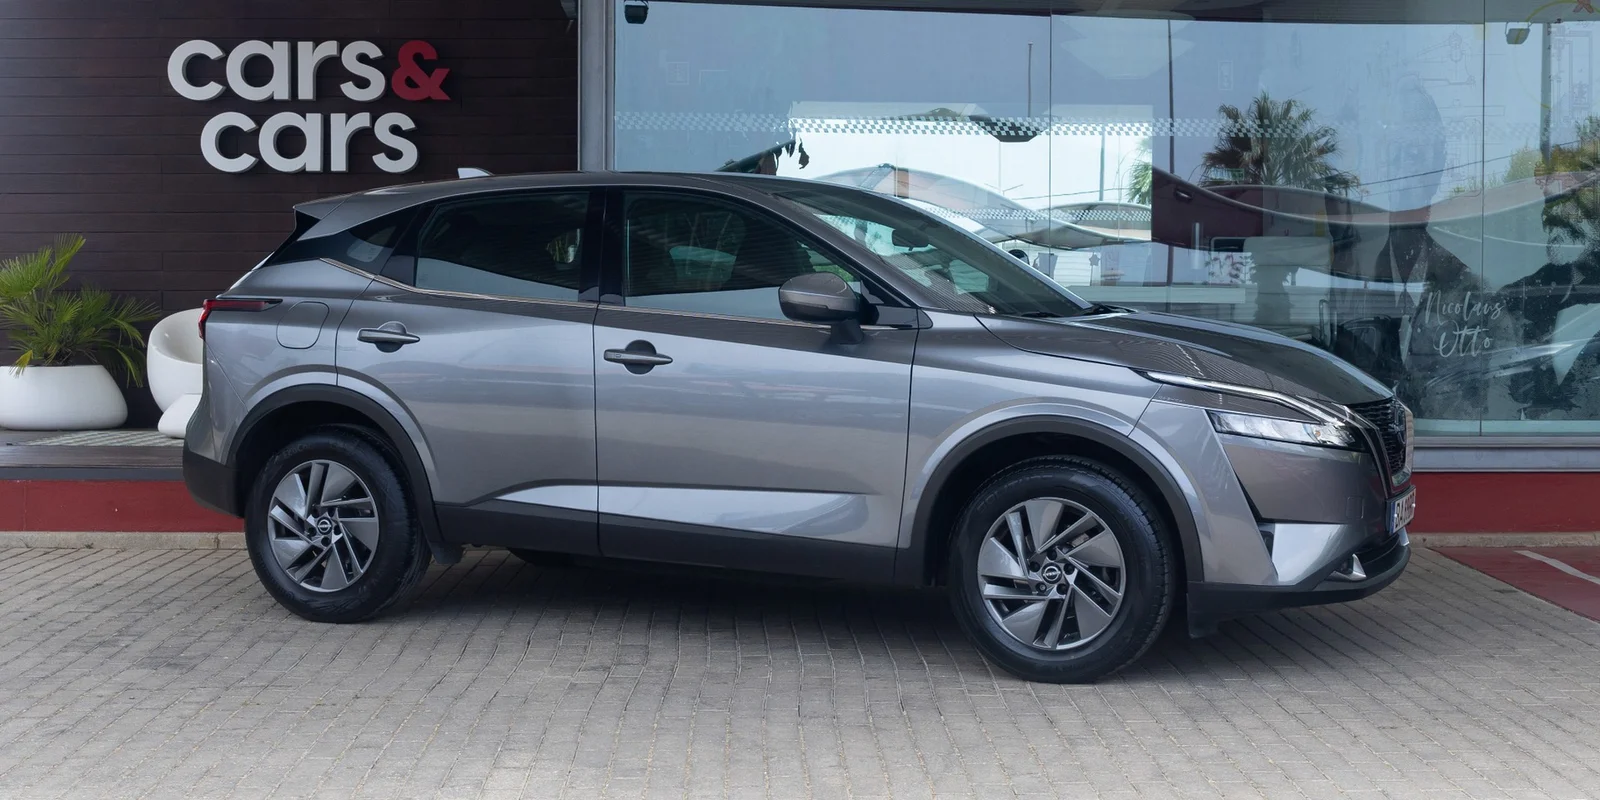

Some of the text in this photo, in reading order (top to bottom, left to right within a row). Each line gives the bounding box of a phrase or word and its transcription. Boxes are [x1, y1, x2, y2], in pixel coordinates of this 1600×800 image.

[200, 111, 419, 172] cars
[1425, 290, 1504, 325] Nicolaus
[1433, 320, 1493, 358] Otto
